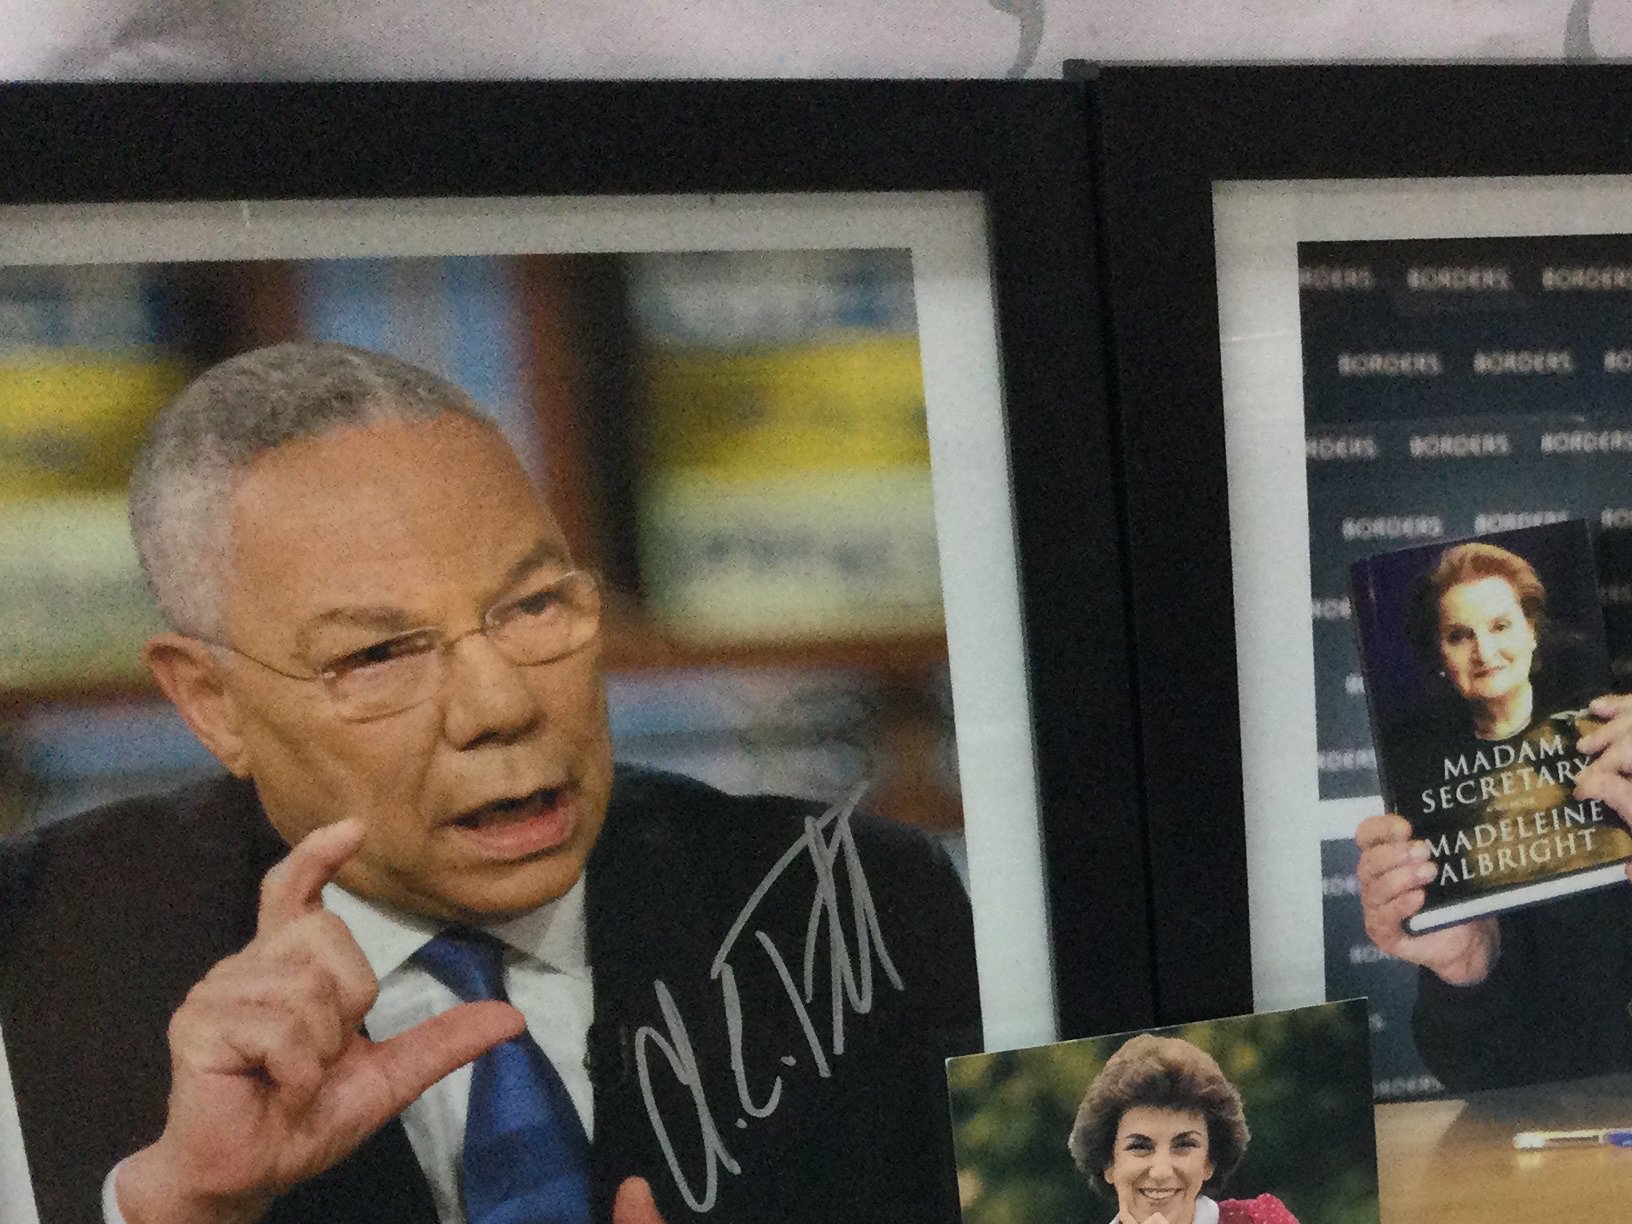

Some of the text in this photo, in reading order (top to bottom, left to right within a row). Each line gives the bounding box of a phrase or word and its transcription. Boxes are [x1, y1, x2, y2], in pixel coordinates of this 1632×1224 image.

[1407, 266, 1511, 291] BORDERS
[1337, 351, 1575, 377] BORDERS BORDERS
[1410, 433, 1511, 459] BORDERS
[1342, 514, 1444, 542] BORDERS
[1444, 734, 1564, 780] MADAM
[1422, 755, 1591, 814] SECRETARY
[1425, 801, 1604, 858] MADELEINE
[1439, 828, 1598, 886] ALBRIGHT
